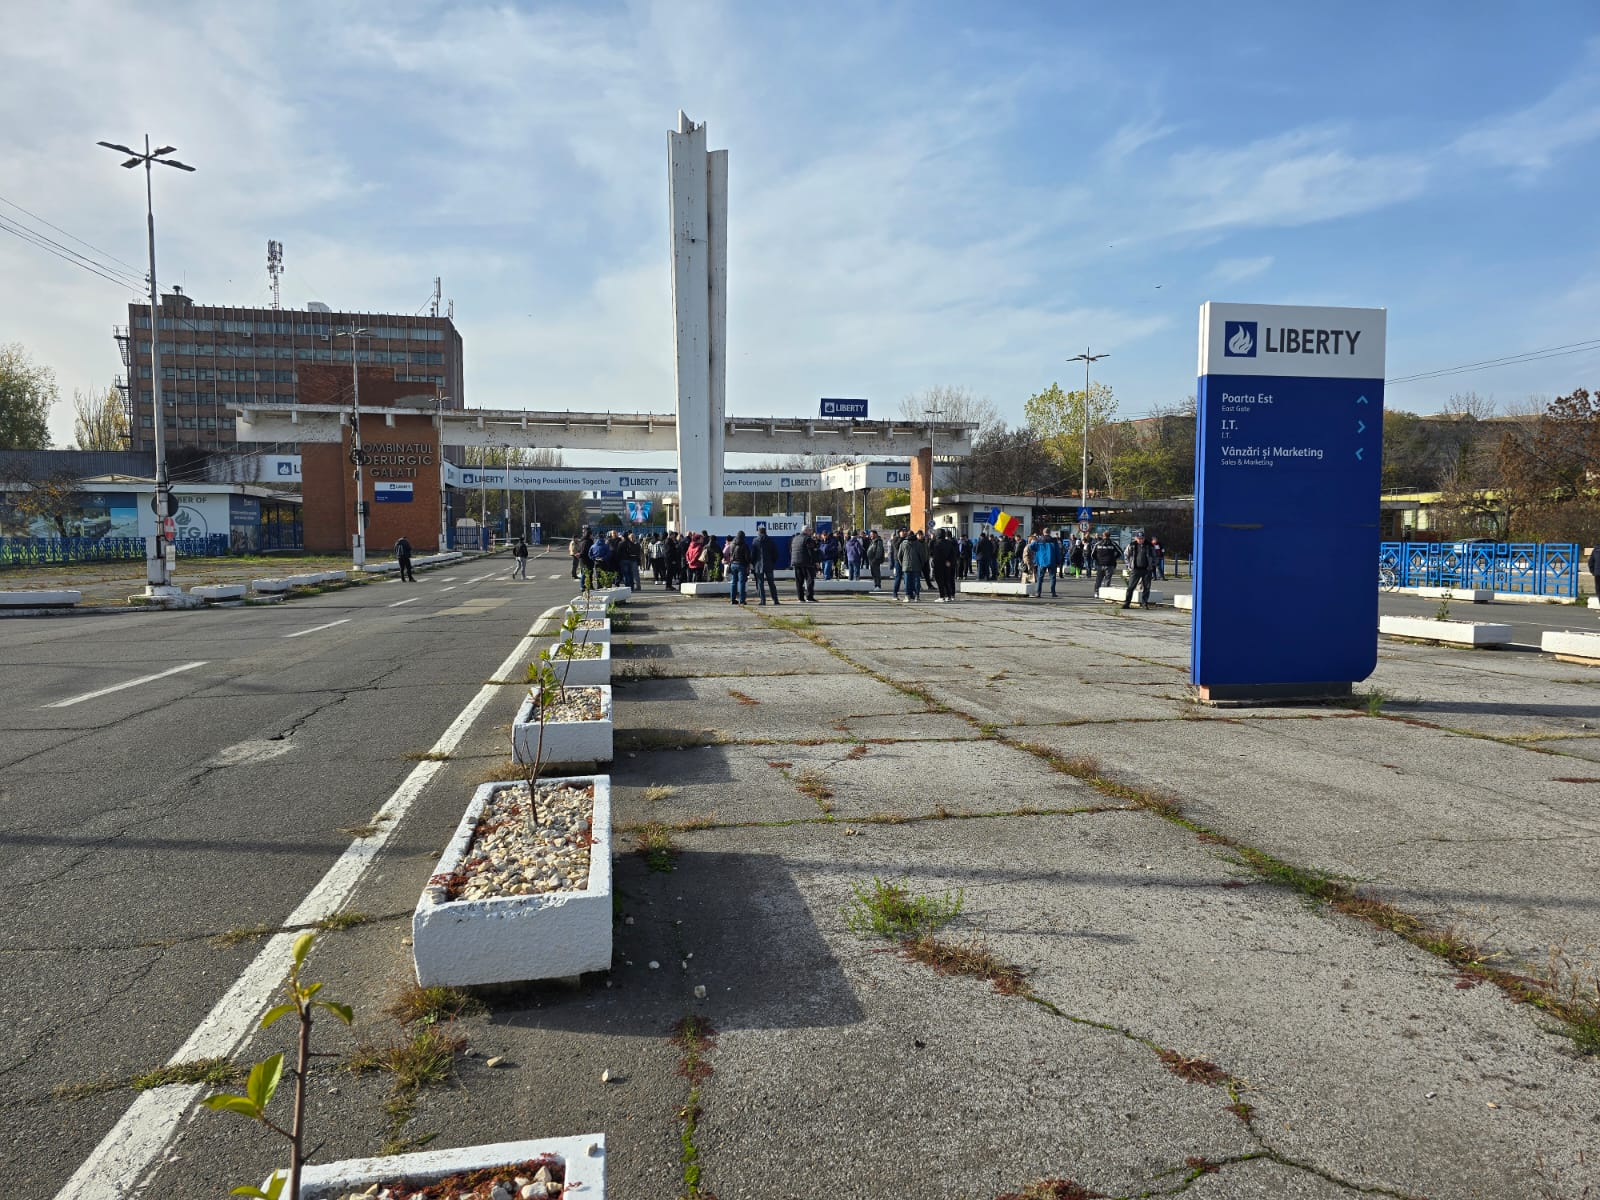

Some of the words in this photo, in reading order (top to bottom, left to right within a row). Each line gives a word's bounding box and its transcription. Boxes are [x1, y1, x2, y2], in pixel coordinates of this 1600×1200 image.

[1265, 328, 1361, 355] LIBERTY
[1222, 393, 1255, 403] Poarta
[1258, 393, 1273, 404] Est
[835, 403, 864, 412] LIBERTY
[1221, 419, 1238, 430] I.T.
[362, 443, 432, 453] OMBINATUL
[1221, 446, 1260, 457] Vânzări
[1262, 447, 1270, 460] și
[1273, 447, 1324, 460] Marketing
[352, 455, 432, 465] SDERURGIC
[1220, 458, 1236, 466] Sales
[1243, 459, 1274, 467] Marketing
[513, 477, 541, 485] Shaping
[542, 477, 581, 485] Possibilities
[582, 478, 611, 486] Together
[630, 478, 659, 486] LIBERTY
[791, 479, 818, 487] LIBERTY
[767, 521, 798, 531] LIBERTY
